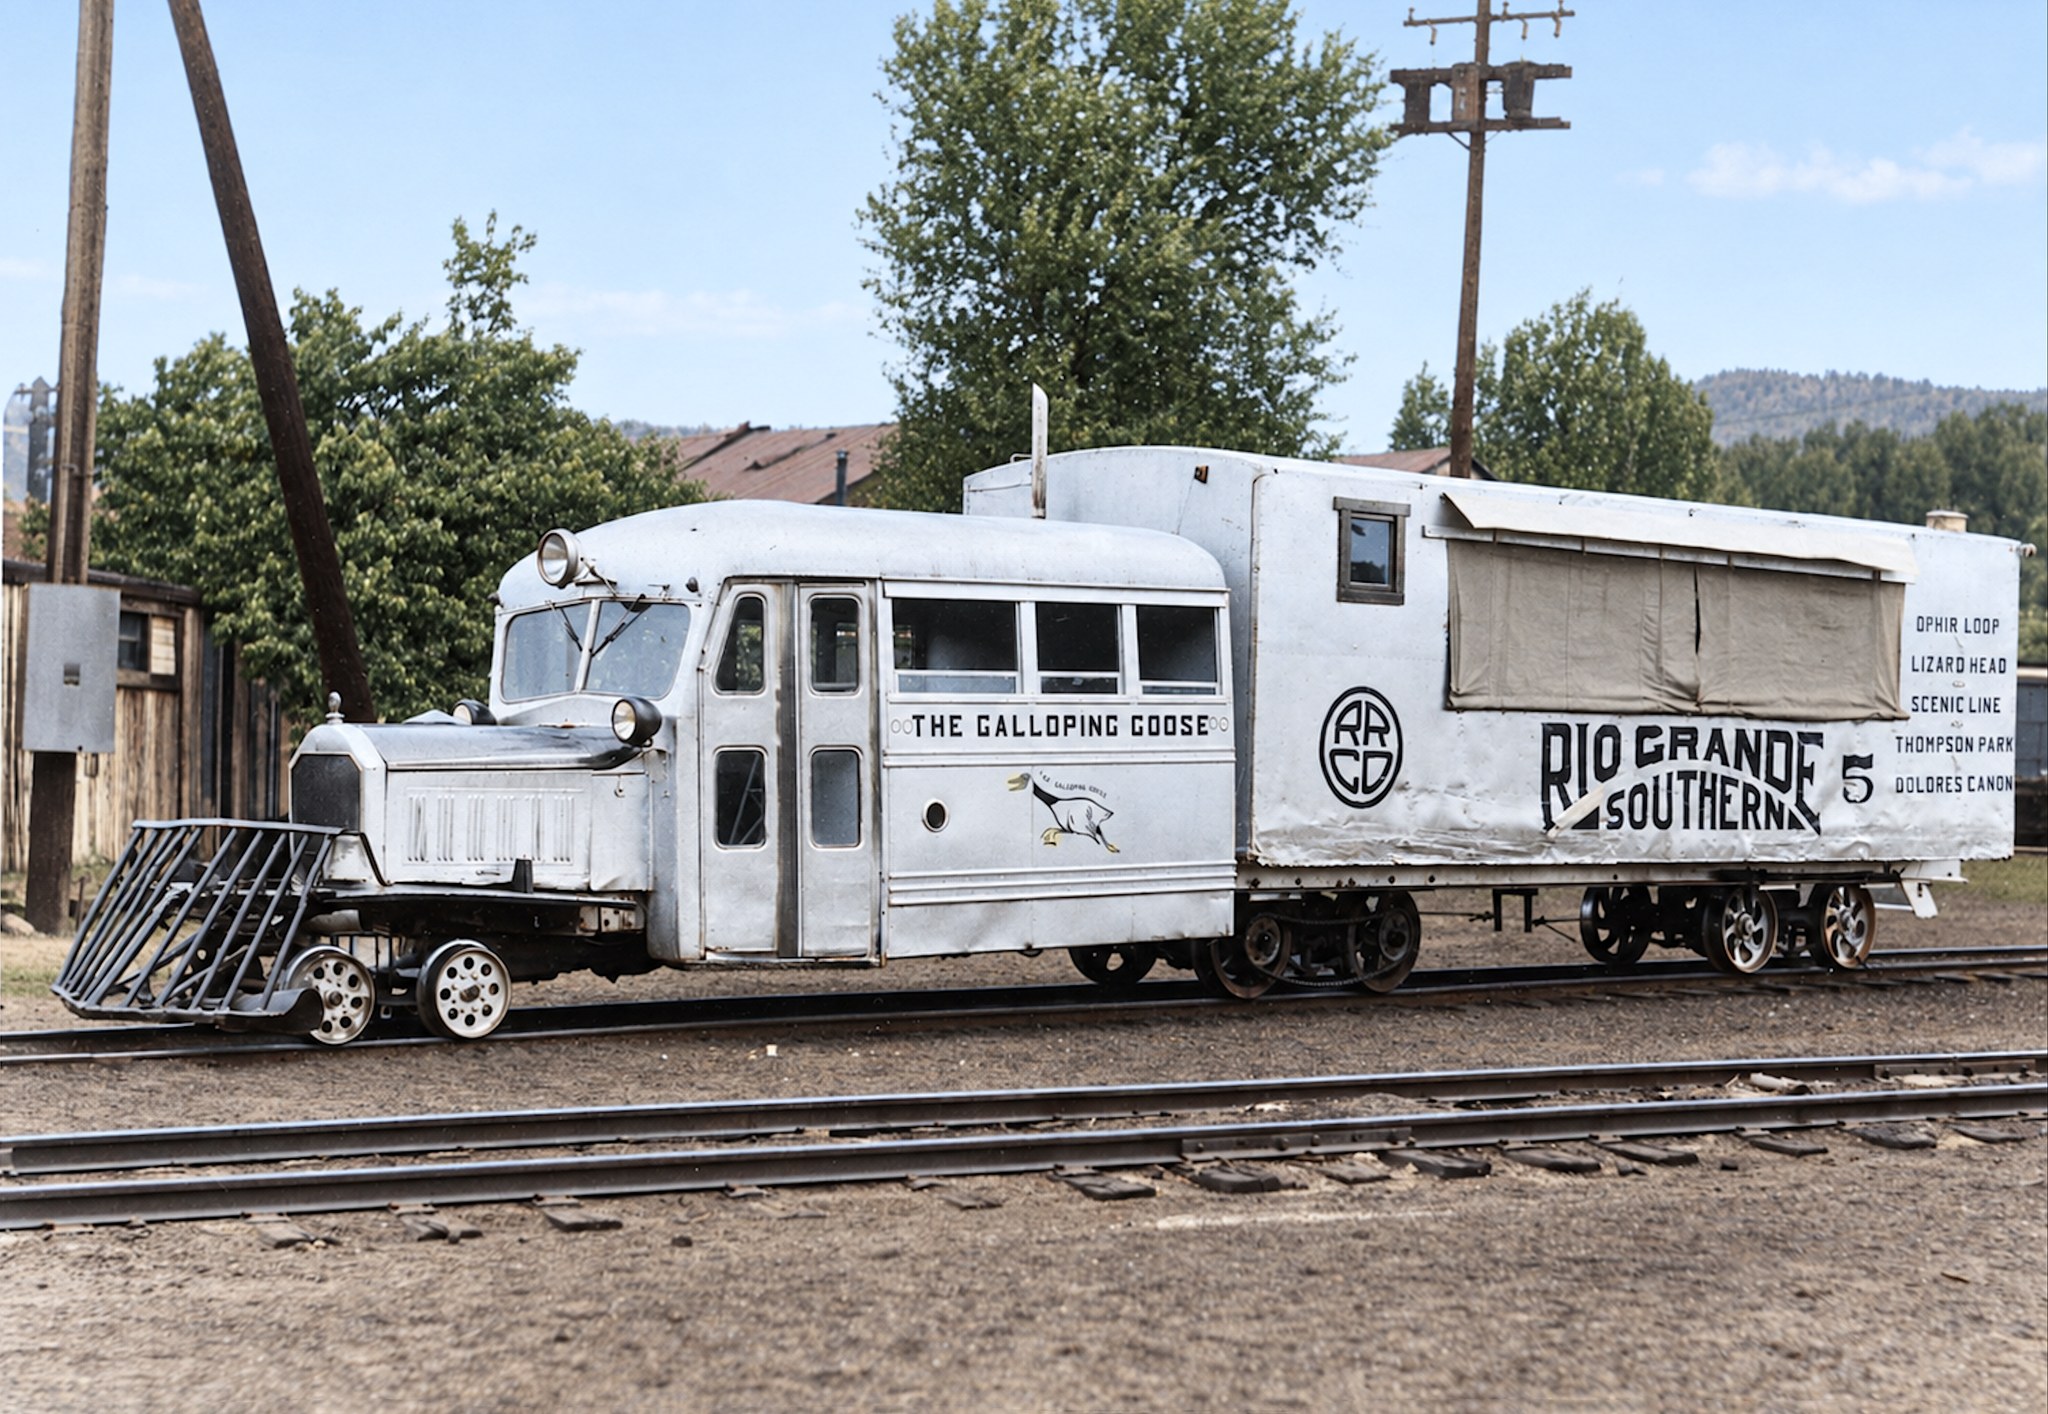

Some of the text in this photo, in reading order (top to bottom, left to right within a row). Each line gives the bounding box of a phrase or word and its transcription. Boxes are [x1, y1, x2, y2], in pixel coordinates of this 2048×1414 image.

[1917, 616, 2000, 635] OPHIR LOOP
[1911, 655, 2007, 674] LIZARD HEAD
[1911, 696, 2001, 713] SCENIC LINE
[912, 714, 1209, 738] THE GALLOPING GOOSE
[1895, 735, 2014, 753] THOMPSON PARK
[1541, 722, 1824, 836] RIO GRANDE
[1842, 753, 1874, 804] 5
[1895, 776, 2013, 793] DOLORES CANON
[1605, 769, 1796, 830] SOUTHERN
